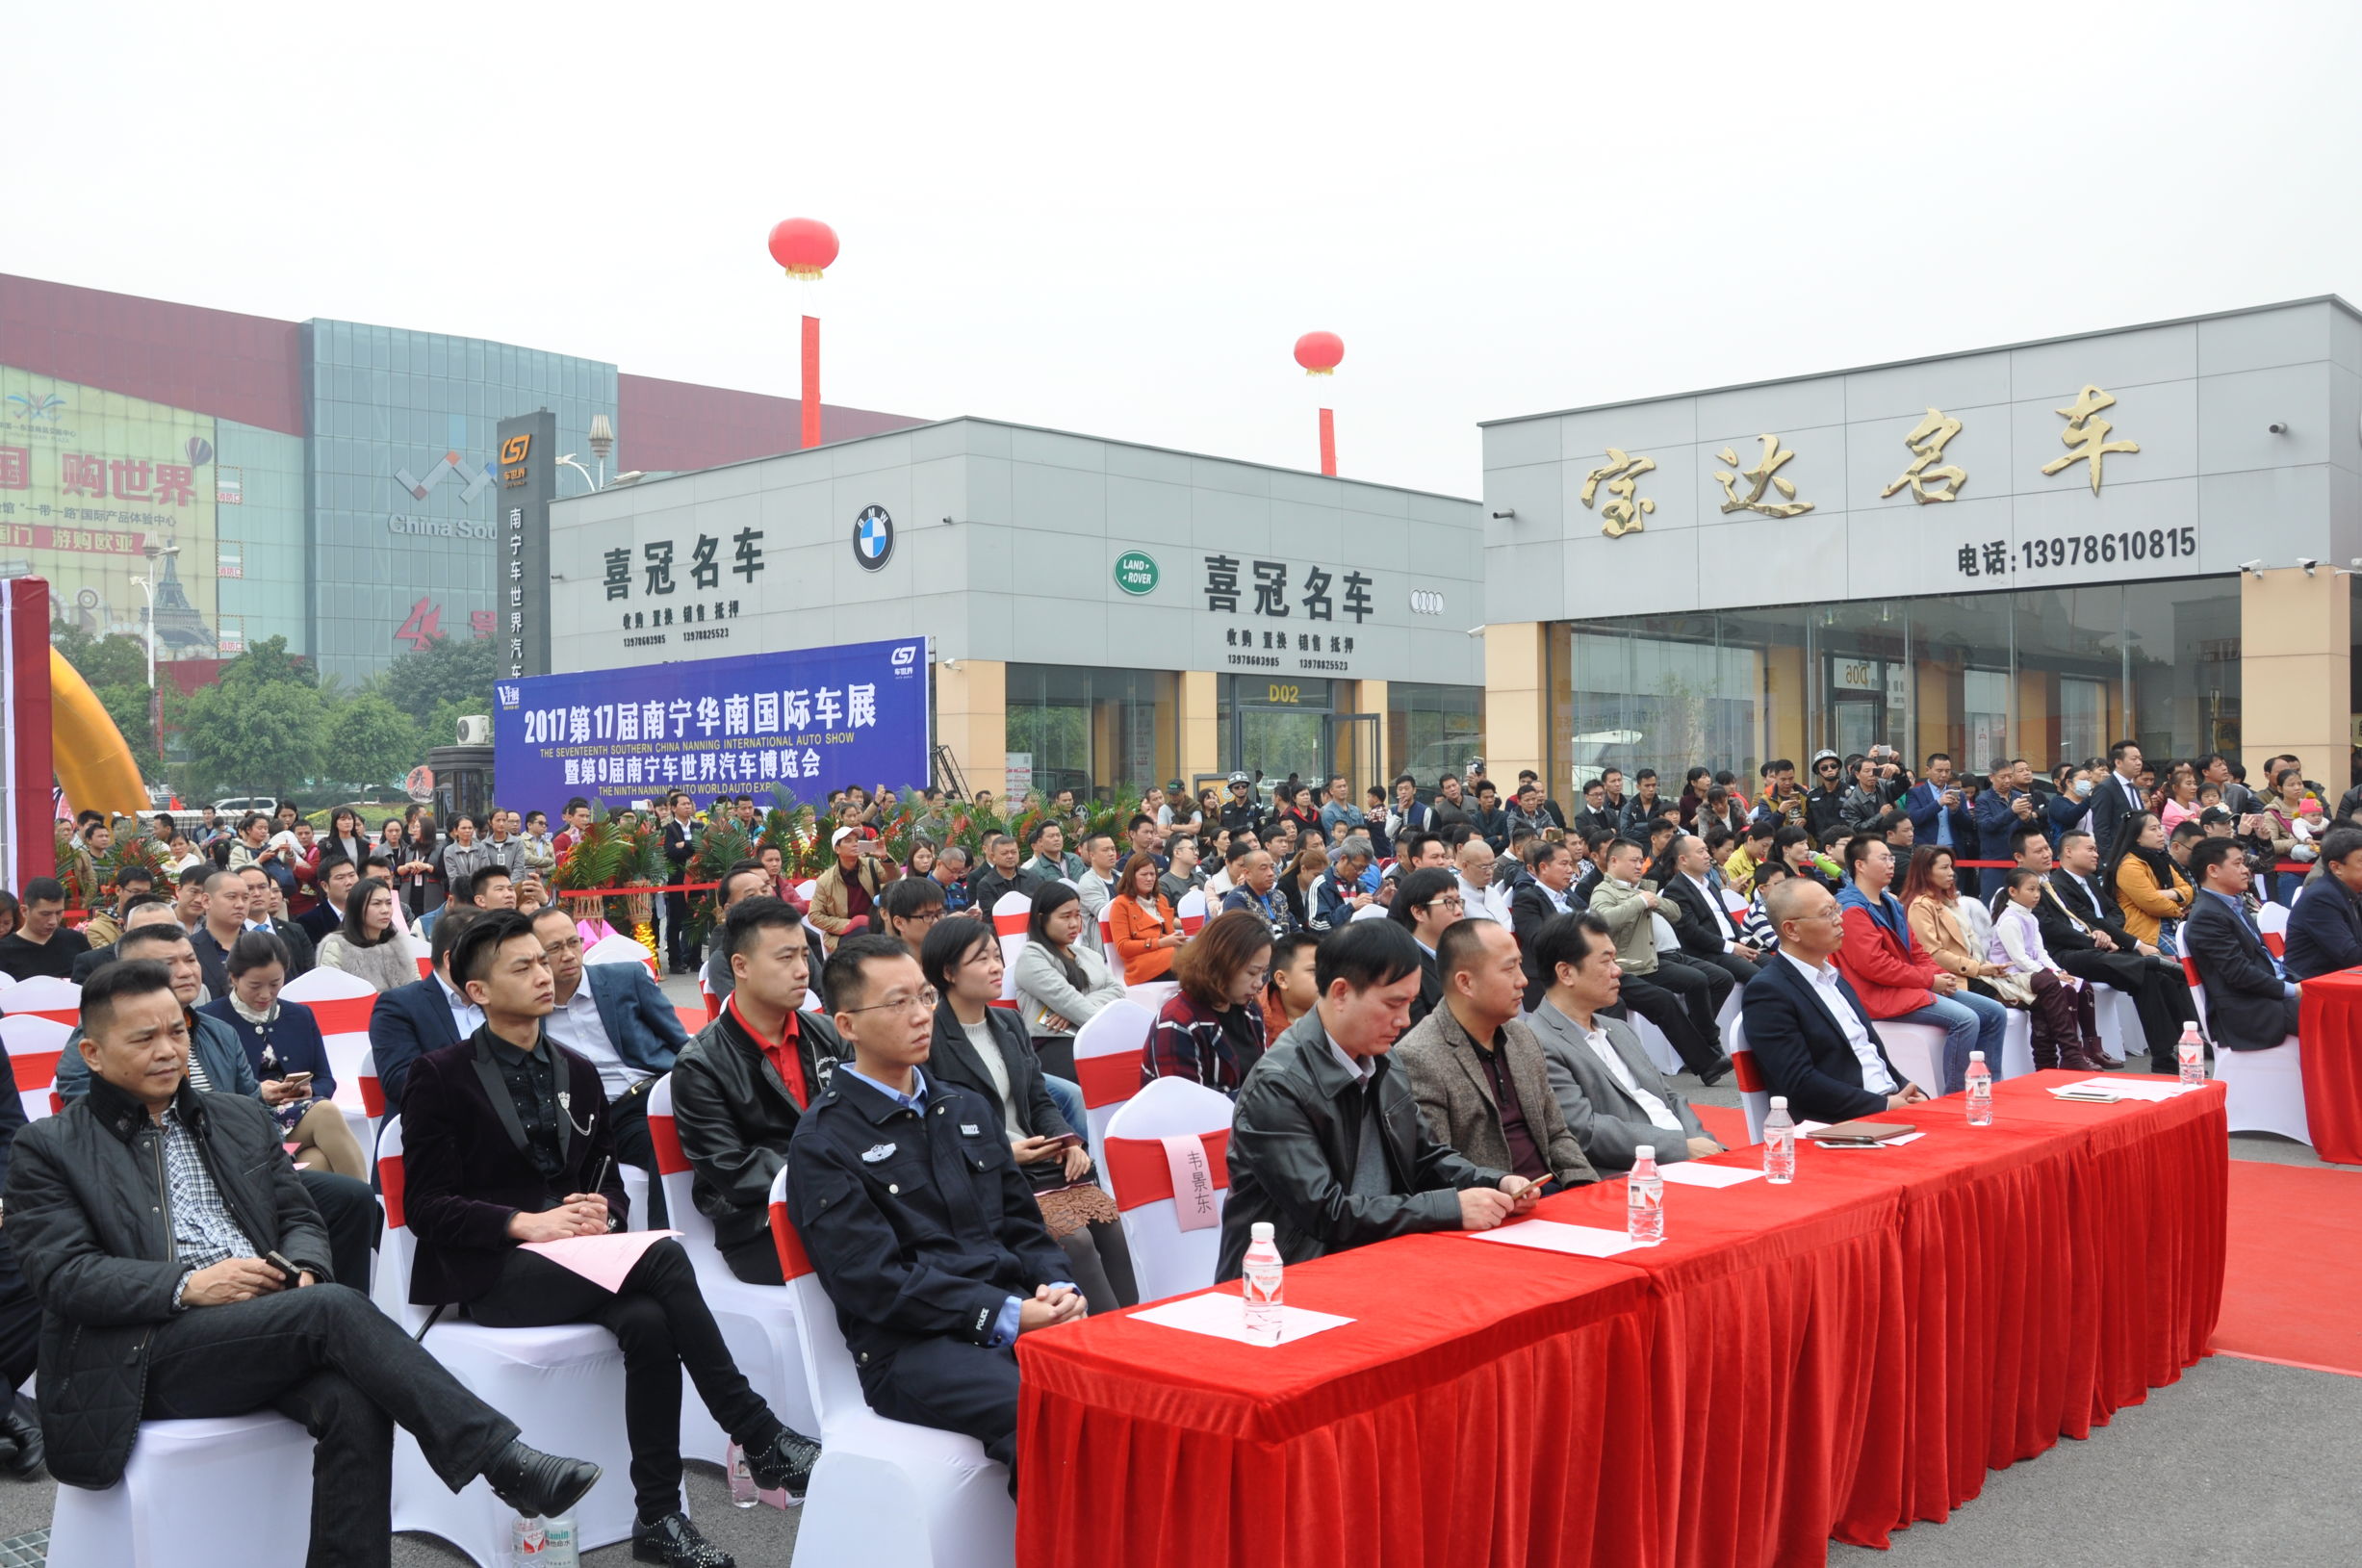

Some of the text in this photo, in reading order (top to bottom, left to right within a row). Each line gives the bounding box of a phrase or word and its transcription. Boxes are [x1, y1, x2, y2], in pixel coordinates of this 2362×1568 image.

[1579, 384, 2141, 540] 宝达名车
[62, 453, 196, 507] 购世界
[388, 513, 451, 536] China
[857, 507, 888, 528] BMW
[52, 530, 134, 553] 游购欧亚
[603, 526, 765, 602] 喜冠名车
[1122, 558, 1144, 571] LAND
[1127, 572, 1152, 584] ROVER
[1203, 554, 1374, 624] 喜冠名车
[509, 507, 523, 679] 南宁车世界汽车
[623, 600, 739, 630] 收购 置换 销售 抵押
[683, 628, 729, 642] 13978825523
[1226, 628, 1353, 654] 收购 置换 销售 抵押
[1299, 658, 1348, 671] 13978825523
[1269, 683, 1299, 704] D02
[524, 681, 878, 744] 2017第17届南宁华南国际车展
[540, 732, 855, 758] THE SEVENTEENTH SOUTHERN CHINA NANNING INTERNATIONAL AUTO SHOW
[564, 747, 821, 785] 暨第9届南宁车世界汽车博览会
[599, 785, 613, 796] THE
[614, 784, 637, 796] NINTH
[698, 783, 729, 794] WORLD
[729, 782, 753, 793] AUTO
[754, 781, 772, 793] EXP
[1187, 1150, 1213, 1214] 韦景东
[975, 1307, 989, 1330] POLICE
